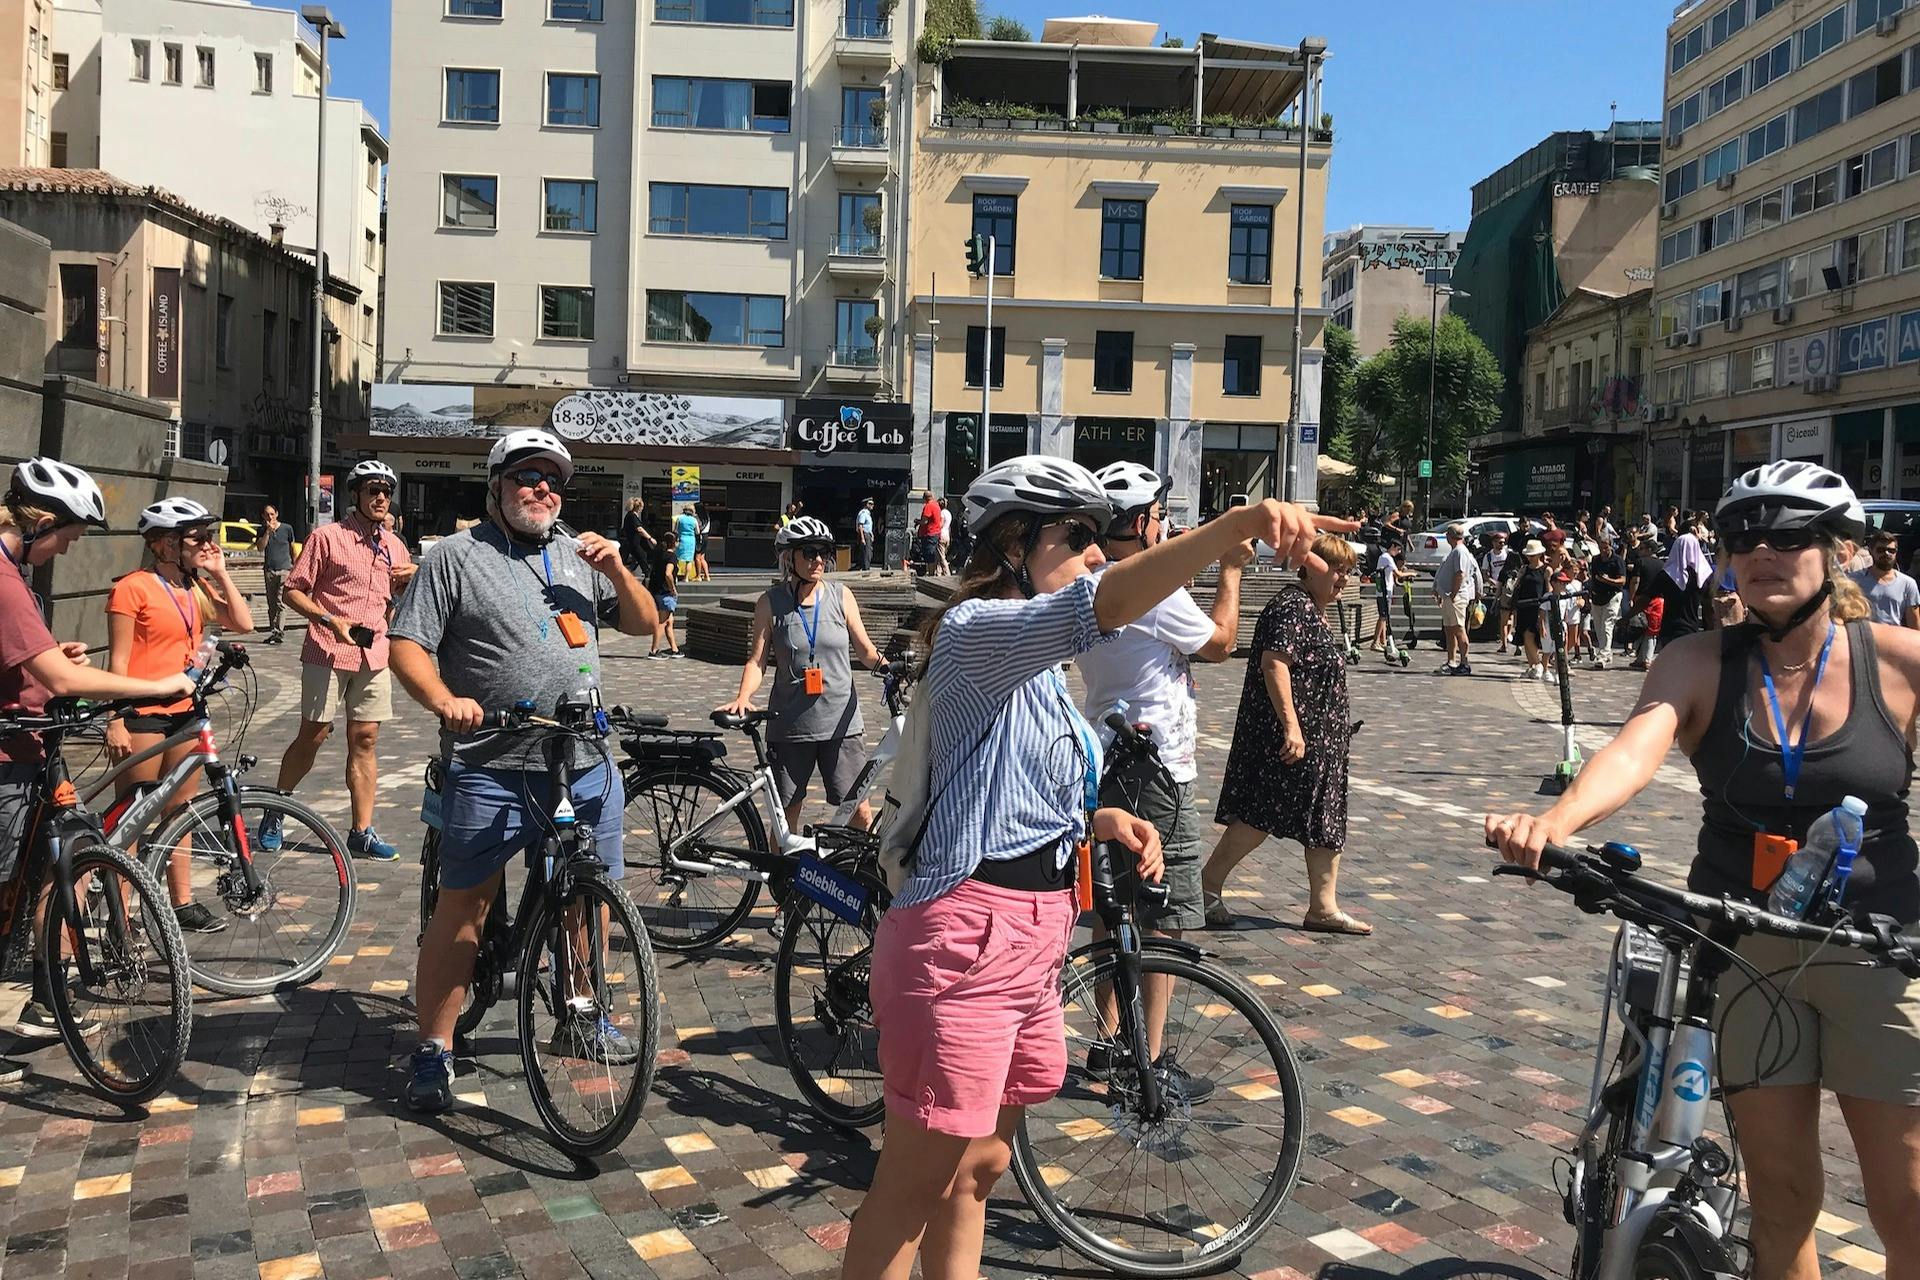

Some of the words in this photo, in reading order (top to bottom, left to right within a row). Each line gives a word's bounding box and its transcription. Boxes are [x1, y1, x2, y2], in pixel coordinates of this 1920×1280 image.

[158, 294, 169, 326] ISLAND
[157, 341, 168, 374] COFFEE
[1849, 327, 1887, 362] CAR
[798, 418, 858, 452] Coffee
[862, 421, 904, 445] Lab
[415, 459, 451, 469] COFFEE
[736, 471, 765, 480] CREPE
[800, 866, 861, 912] solebike.eu
